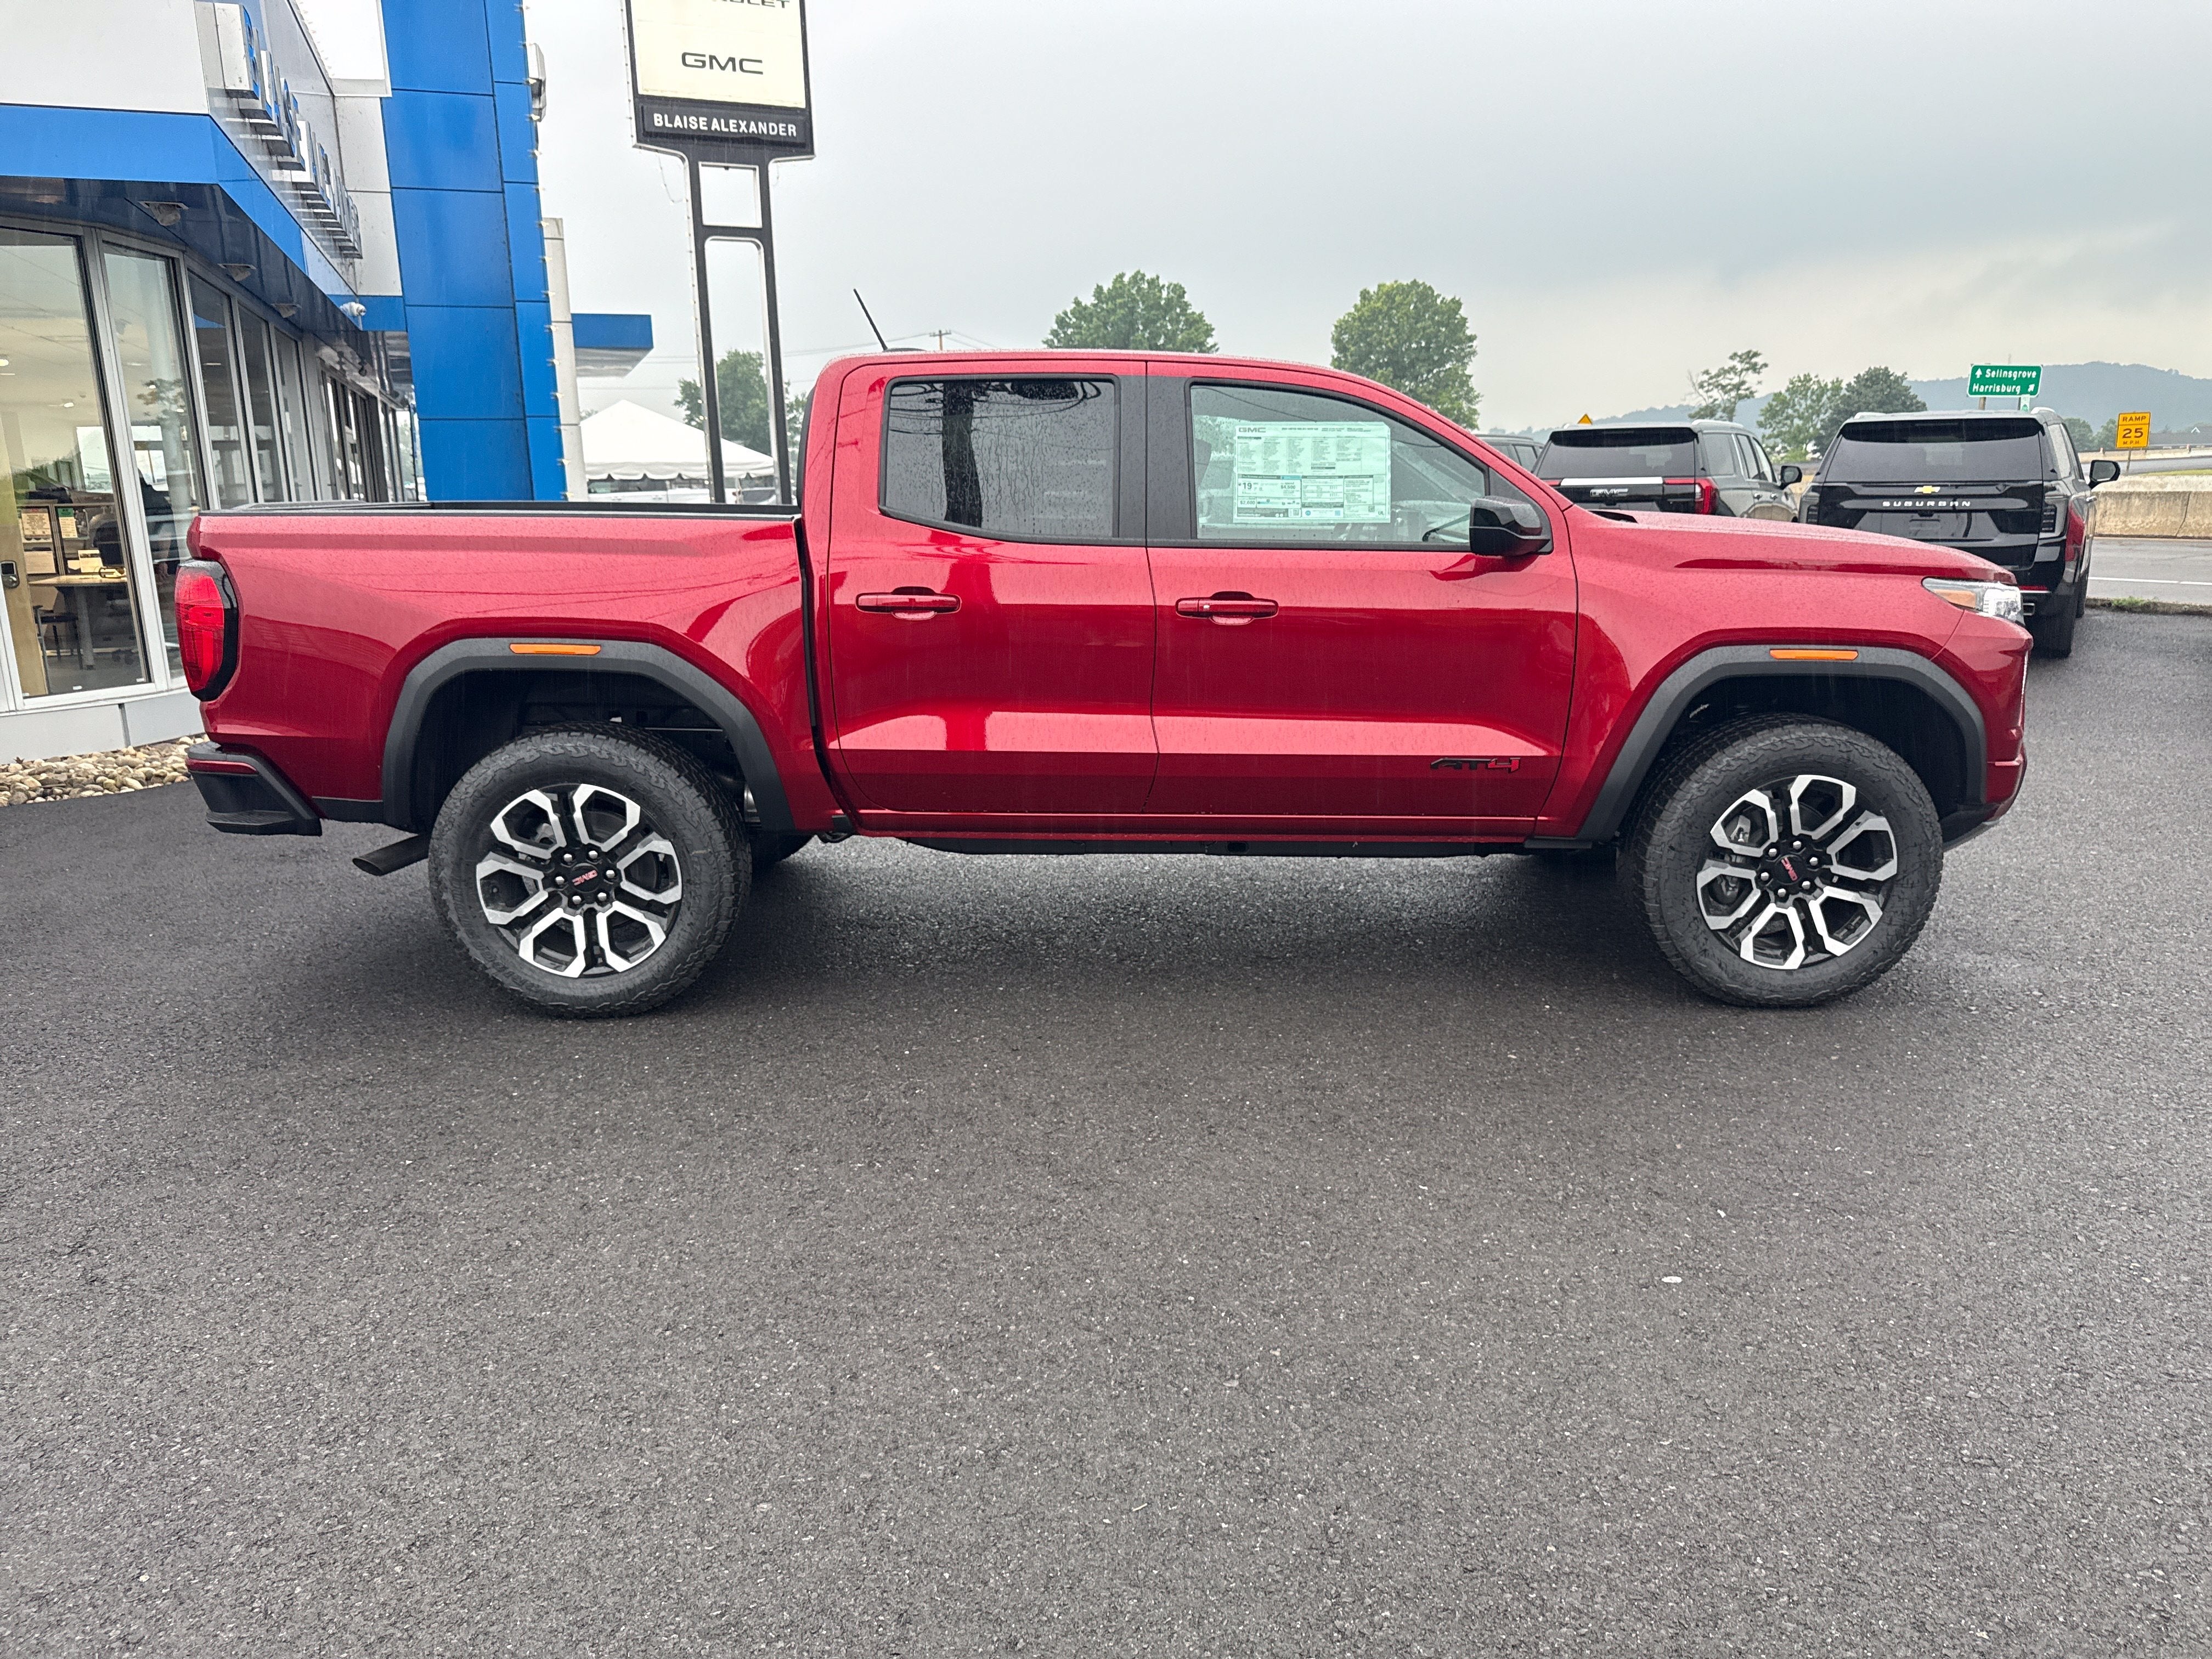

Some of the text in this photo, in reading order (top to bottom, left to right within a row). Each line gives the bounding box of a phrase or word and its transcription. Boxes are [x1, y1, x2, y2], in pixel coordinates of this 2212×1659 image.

[681, 52, 764, 75] GMC
[653, 112, 797, 137] BLAISE ALEXANDER
[1985, 368, 2037, 381] Selinsgrove
[1972, 383, 2021, 395] Harrisburg
[2122, 428, 2143, 438] 25
[1590, 488, 1629, 497] GMC
